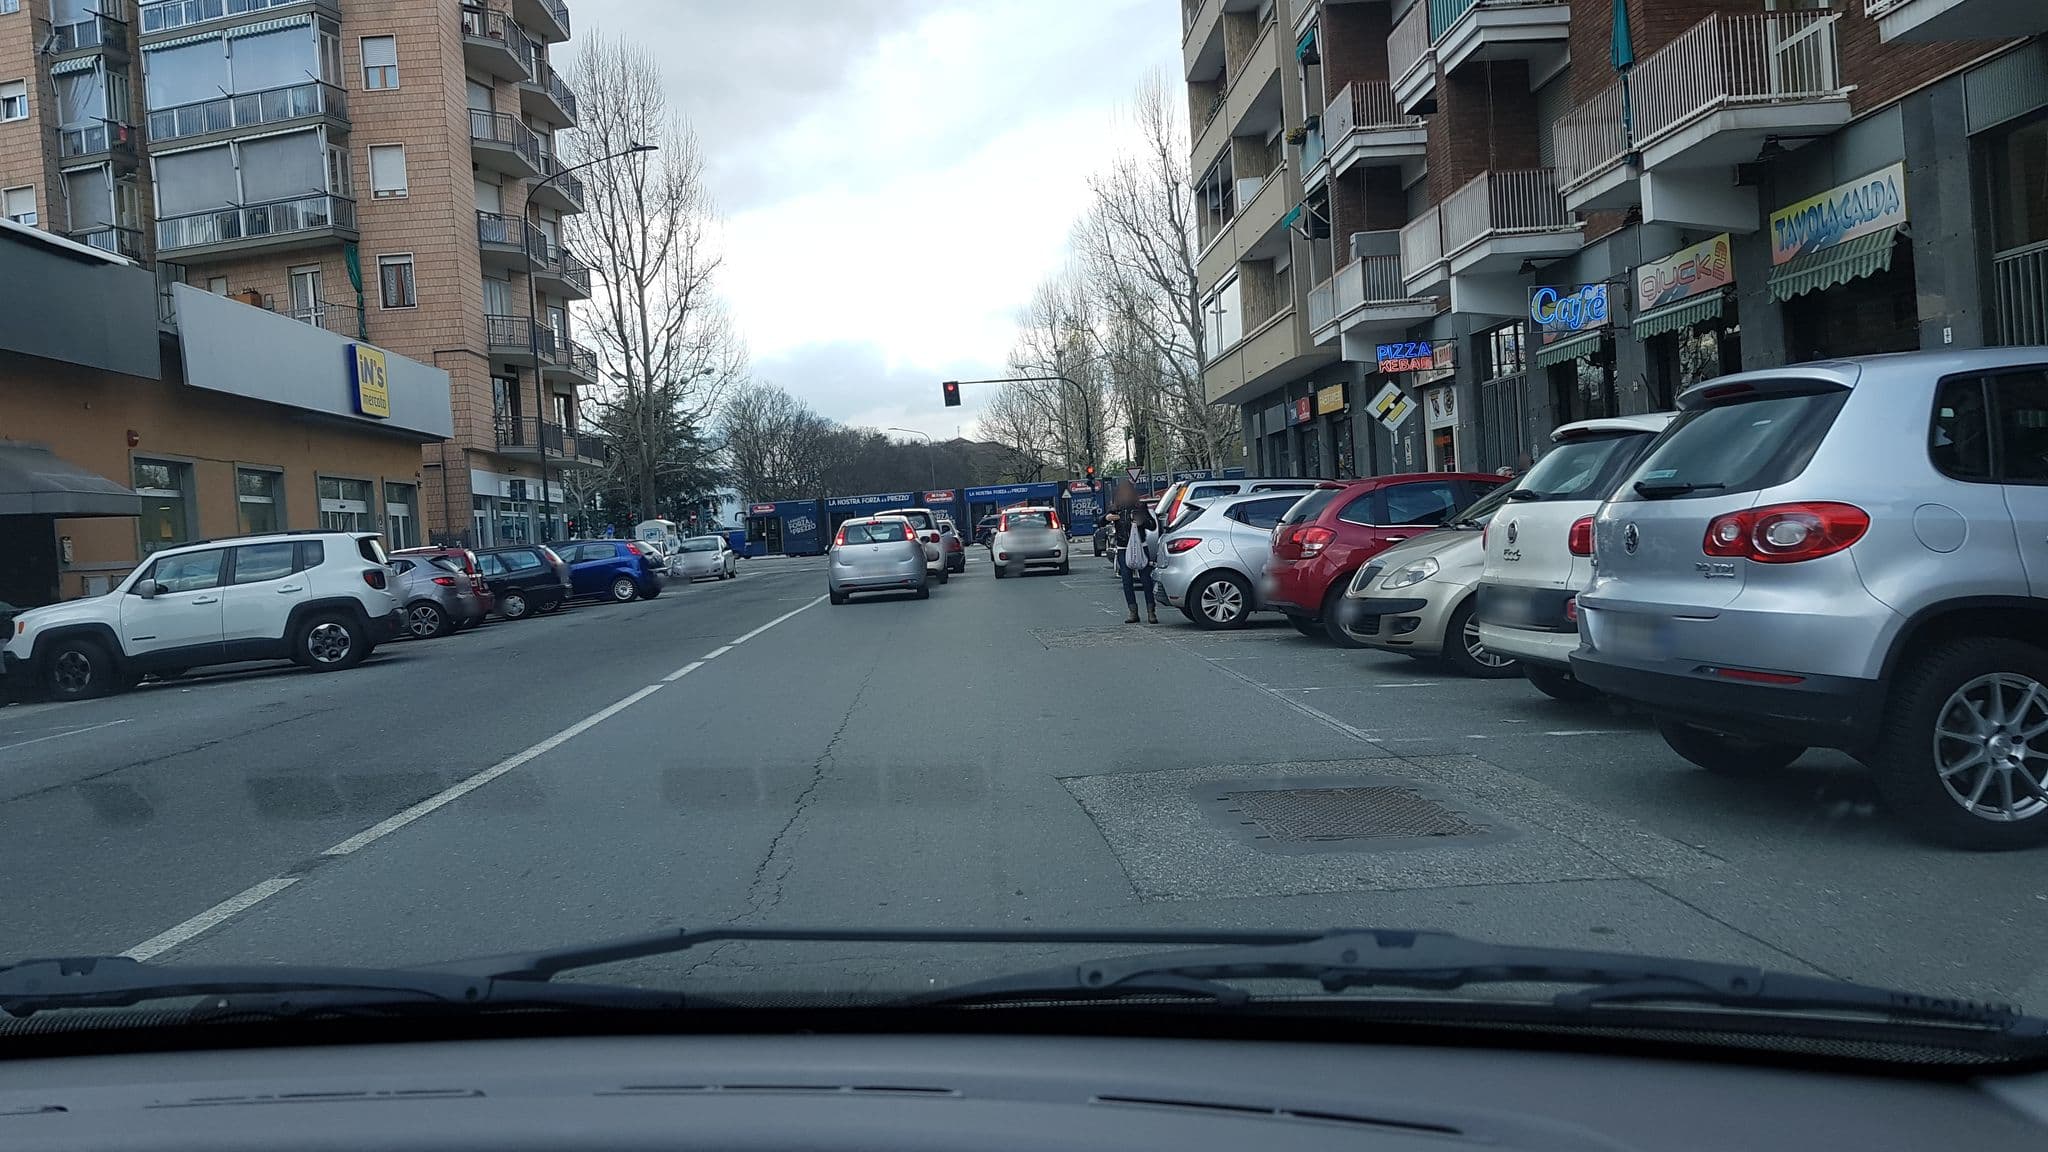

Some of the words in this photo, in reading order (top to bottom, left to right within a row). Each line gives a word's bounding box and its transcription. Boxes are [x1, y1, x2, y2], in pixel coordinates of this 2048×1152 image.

[1775, 198, 1840, 251] TAVOLA
[1840, 174, 1900, 229] CALDA
[1531, 285, 1607, 329] Café
[1376, 341, 1432, 360] PIZZA
[837, 498, 861, 506] NOSTRA
[887, 494, 910, 502] PREZZO
[1075, 508, 1102, 516] PREZO
[788, 518, 811, 531] FORZA
